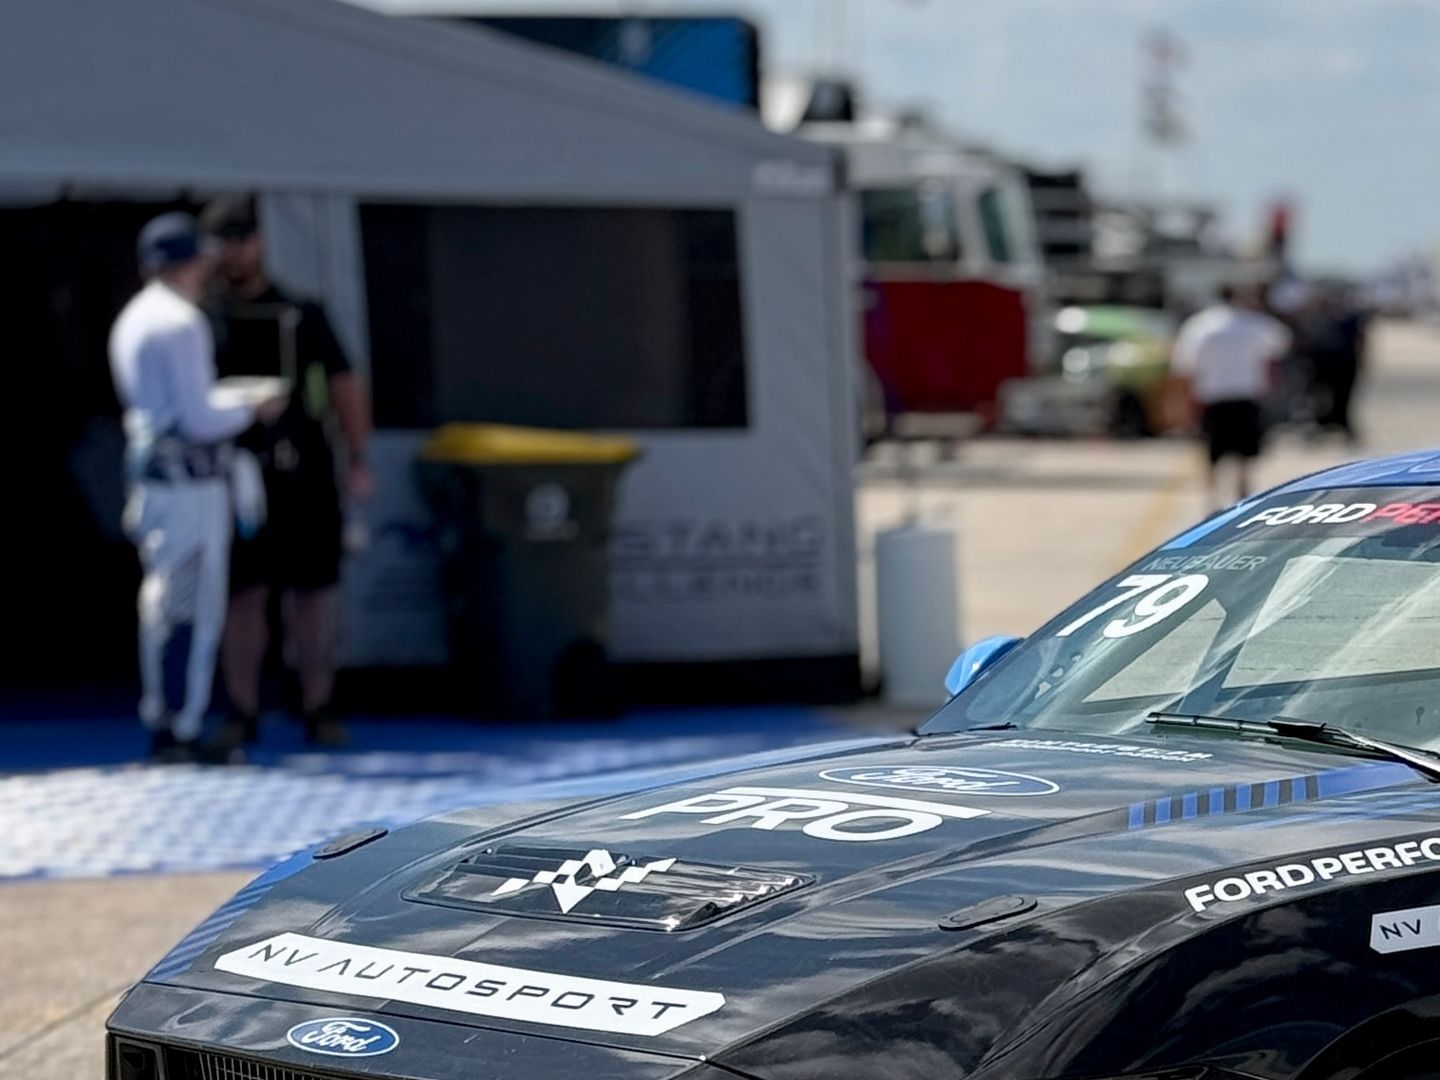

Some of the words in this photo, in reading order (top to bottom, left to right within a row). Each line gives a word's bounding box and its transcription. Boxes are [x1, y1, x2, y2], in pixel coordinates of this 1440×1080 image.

[1142, 553, 1268, 573] NEUBAUER
[1055, 573, 1209, 639] 79
[850, 768, 1020, 792] Ford
[620, 793, 943, 842] PRO
[1379, 919, 1422, 941] NV
[249, 943, 318, 973] NV
[320, 958, 688, 1020] AUTOSPORT
[301, 1019, 381, 1054] Ford
